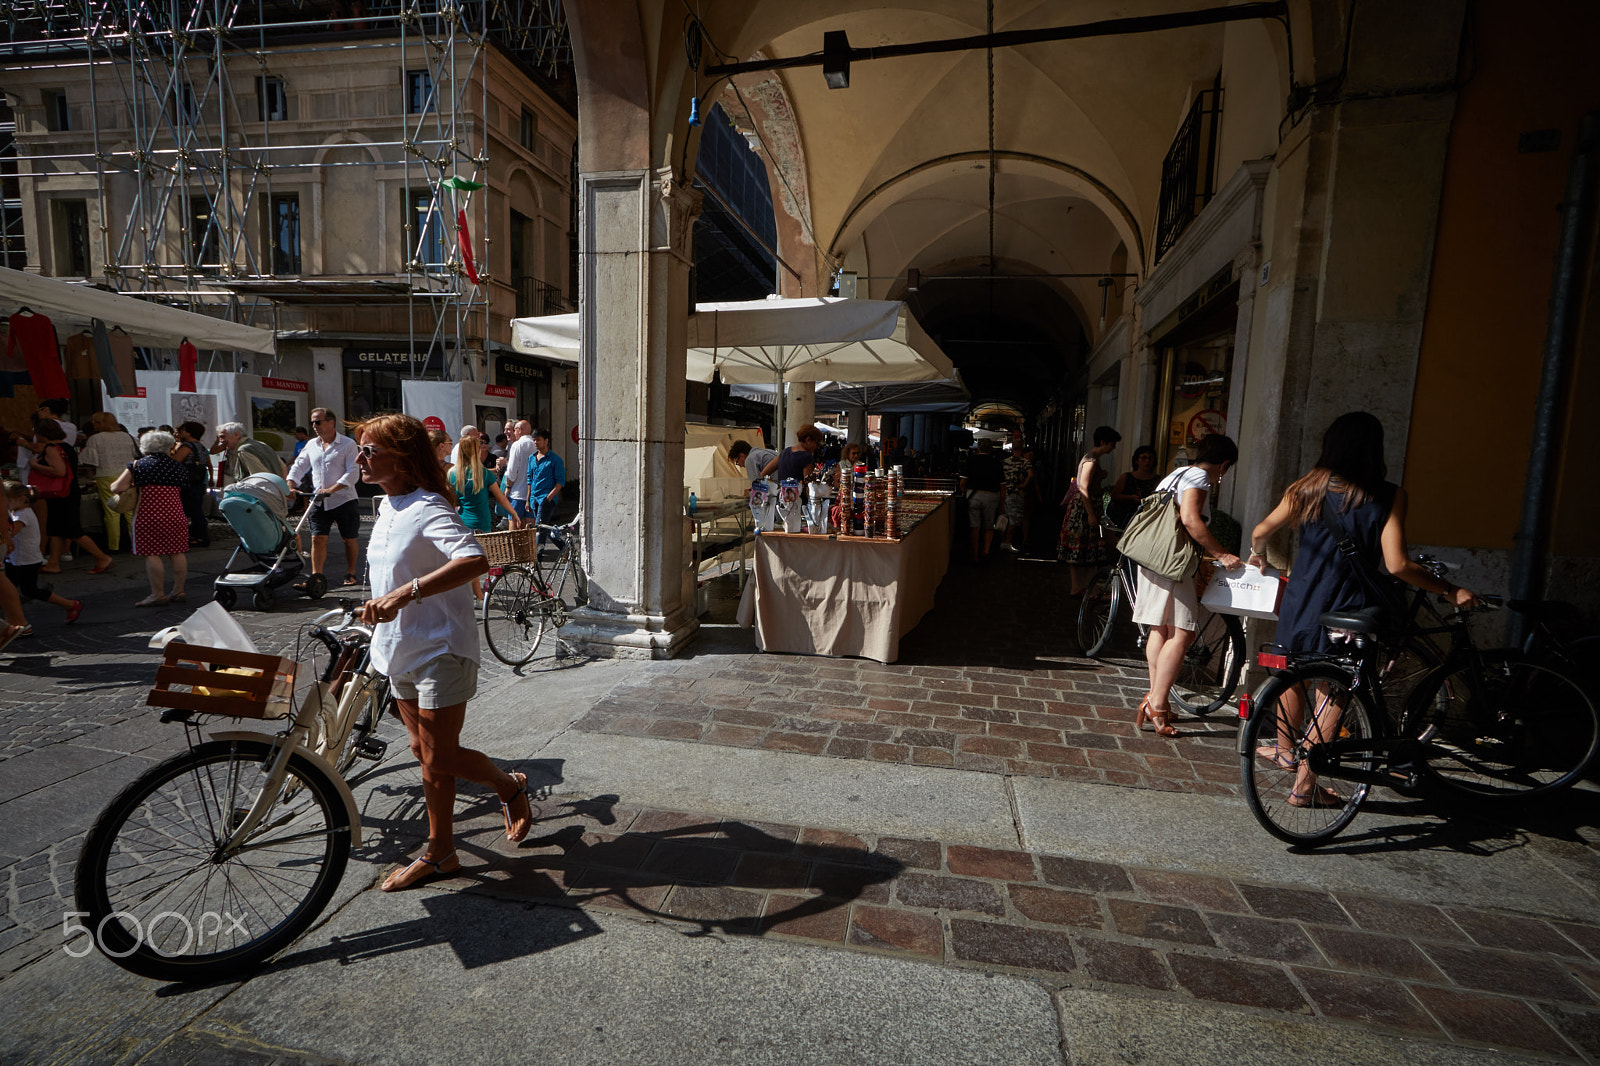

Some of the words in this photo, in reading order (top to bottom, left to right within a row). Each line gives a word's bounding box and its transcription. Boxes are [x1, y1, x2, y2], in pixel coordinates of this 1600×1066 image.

[358, 352, 430, 362] GELATERIA
[504, 362, 544, 378] GELATERIA
[276, 380, 306, 390] MANTOVA
[1218, 580, 1253, 590] swatch
